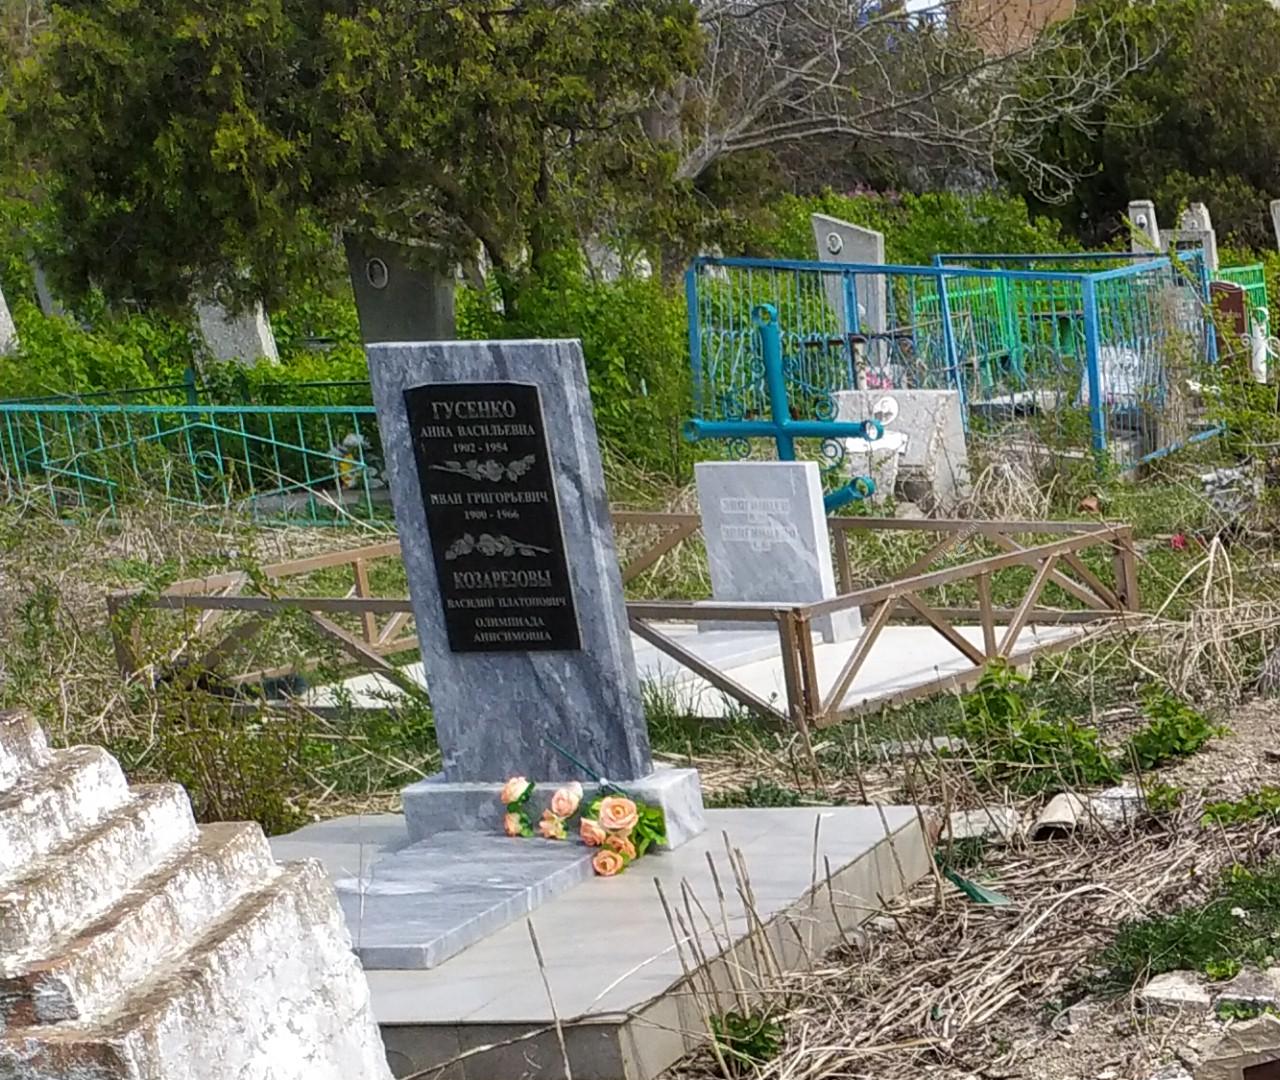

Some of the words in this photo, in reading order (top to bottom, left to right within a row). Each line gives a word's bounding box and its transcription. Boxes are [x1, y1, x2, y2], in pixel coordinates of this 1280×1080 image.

[431, 400, 517, 420] ГУСЕНКО
[420, 426, 453, 438] АННА
[457, 424, 536, 437] ВАСИЛЬЕВНА
[430, 494, 463, 505] ИВАН
[467, 491, 549, 505] ГРИГОРЬЕВИЧ
[453, 570, 553, 589] КОЗАРЕЗОВЫ
[447, 597, 495, 609] ВАСИЛИЙ
